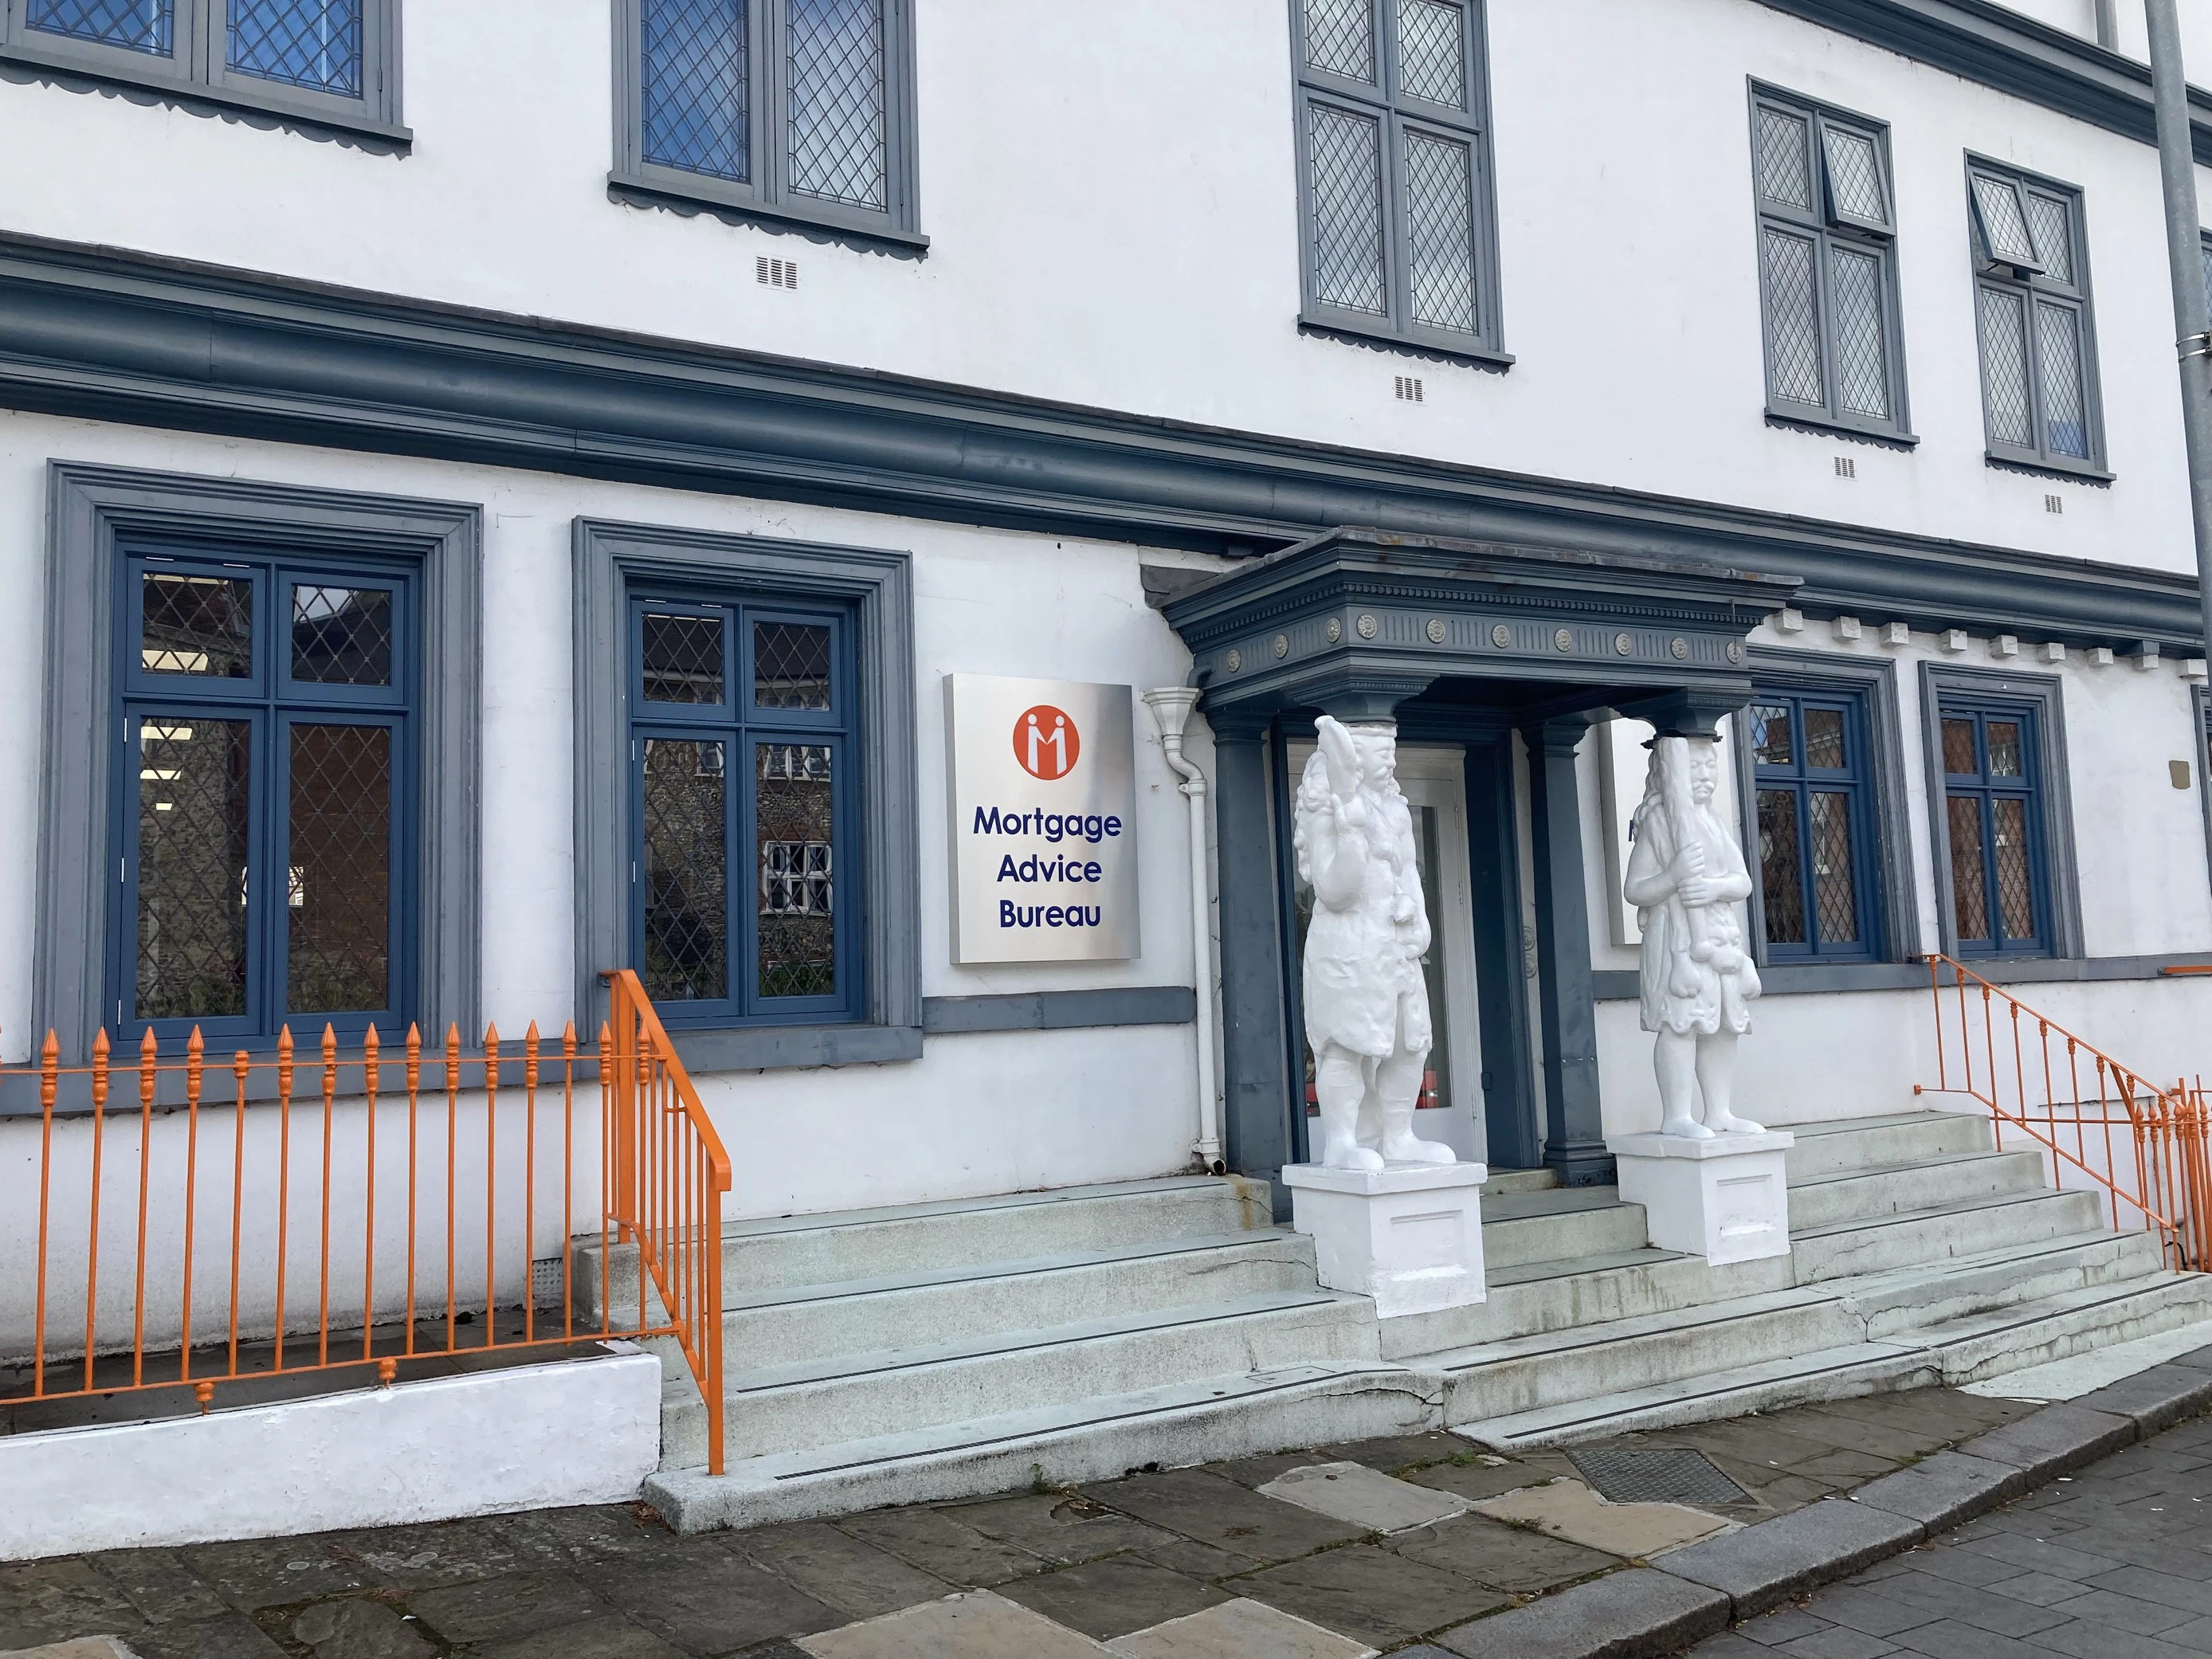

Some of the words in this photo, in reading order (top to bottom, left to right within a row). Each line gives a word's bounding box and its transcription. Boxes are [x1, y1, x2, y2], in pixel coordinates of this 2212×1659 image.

[974, 806, 1122, 843] Mortgage
[998, 853, 1102, 882] Advice
[1000, 900, 1100, 928] Bureau
